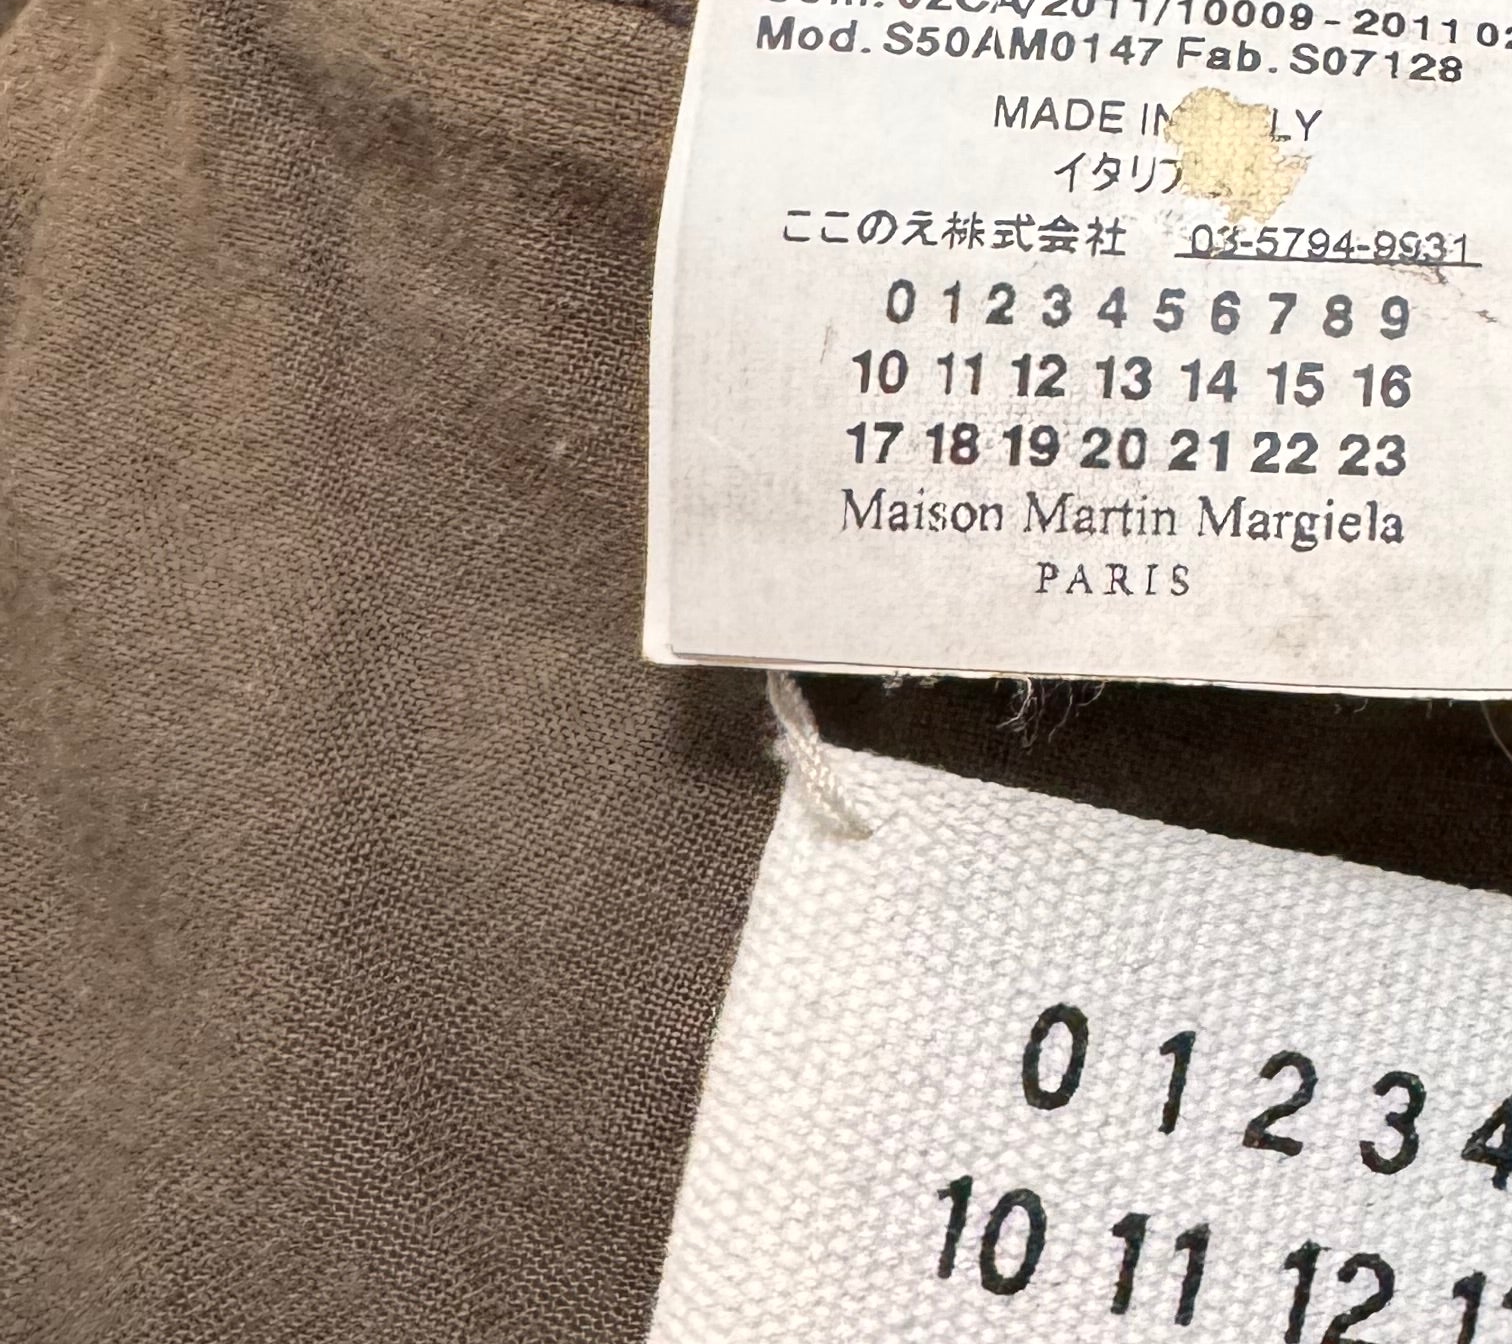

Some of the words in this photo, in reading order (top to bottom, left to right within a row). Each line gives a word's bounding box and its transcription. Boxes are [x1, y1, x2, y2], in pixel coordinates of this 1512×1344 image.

[756, 15, 872, 54] Mod.
[882, 20, 1163, 67] S50AM0147
[1176, 36, 1278, 74] Fab.
[1288, 42, 1463, 82] S07128
[1352, 8, 1458, 44] 2011
[994, 95, 1126, 134] MADE
[783, 209, 1128, 257] ここのえ株式会社
[887, 280, 915, 323] 0
[944, 281, 960, 323] 1
[986, 283, 1015, 324] 2
[1043, 285, 1071, 328] 3
[1098, 288, 1126, 328] 4
[1154, 289, 1185, 332] 5
[1212, 291, 1240, 331] 6
[1270, 293, 1296, 333] 7
[1324, 295, 1352, 337] 8
[1381, 296, 1408, 339] 9
[853, 350, 908, 393] 10
[938, 352, 982, 395] 11
[1012, 354, 1066, 397] 12
[1097, 356, 1151, 400] 13
[1181, 360, 1237, 402] 14
[1268, 362, 1323, 406] 15
[1354, 365, 1411, 407] 16
[847, 422, 903, 463] 17
[927, 423, 979, 464] 18
[1003, 425, 1059, 466] 19
[1080, 428, 1146, 469] 20
[1169, 429, 1229, 471] 21
[1251, 432, 1318, 474] 22
[1339, 434, 1405, 475] 23
[840, 486, 1004, 533] Maison
[1022, 495, 1178, 538] Martin
[1197, 496, 1405, 553] Margiela
[1036, 562, 1192, 598] PARIS
[1022, 1003, 1088, 1110] 0
[1159, 1031, 1195, 1134] 1
[1243, 1051, 1318, 1156] 2
[1360, 1071, 1426, 1175] 3
[938, 1176, 1046, 1295] 10
[1111, 1213, 1210, 1326] 11
